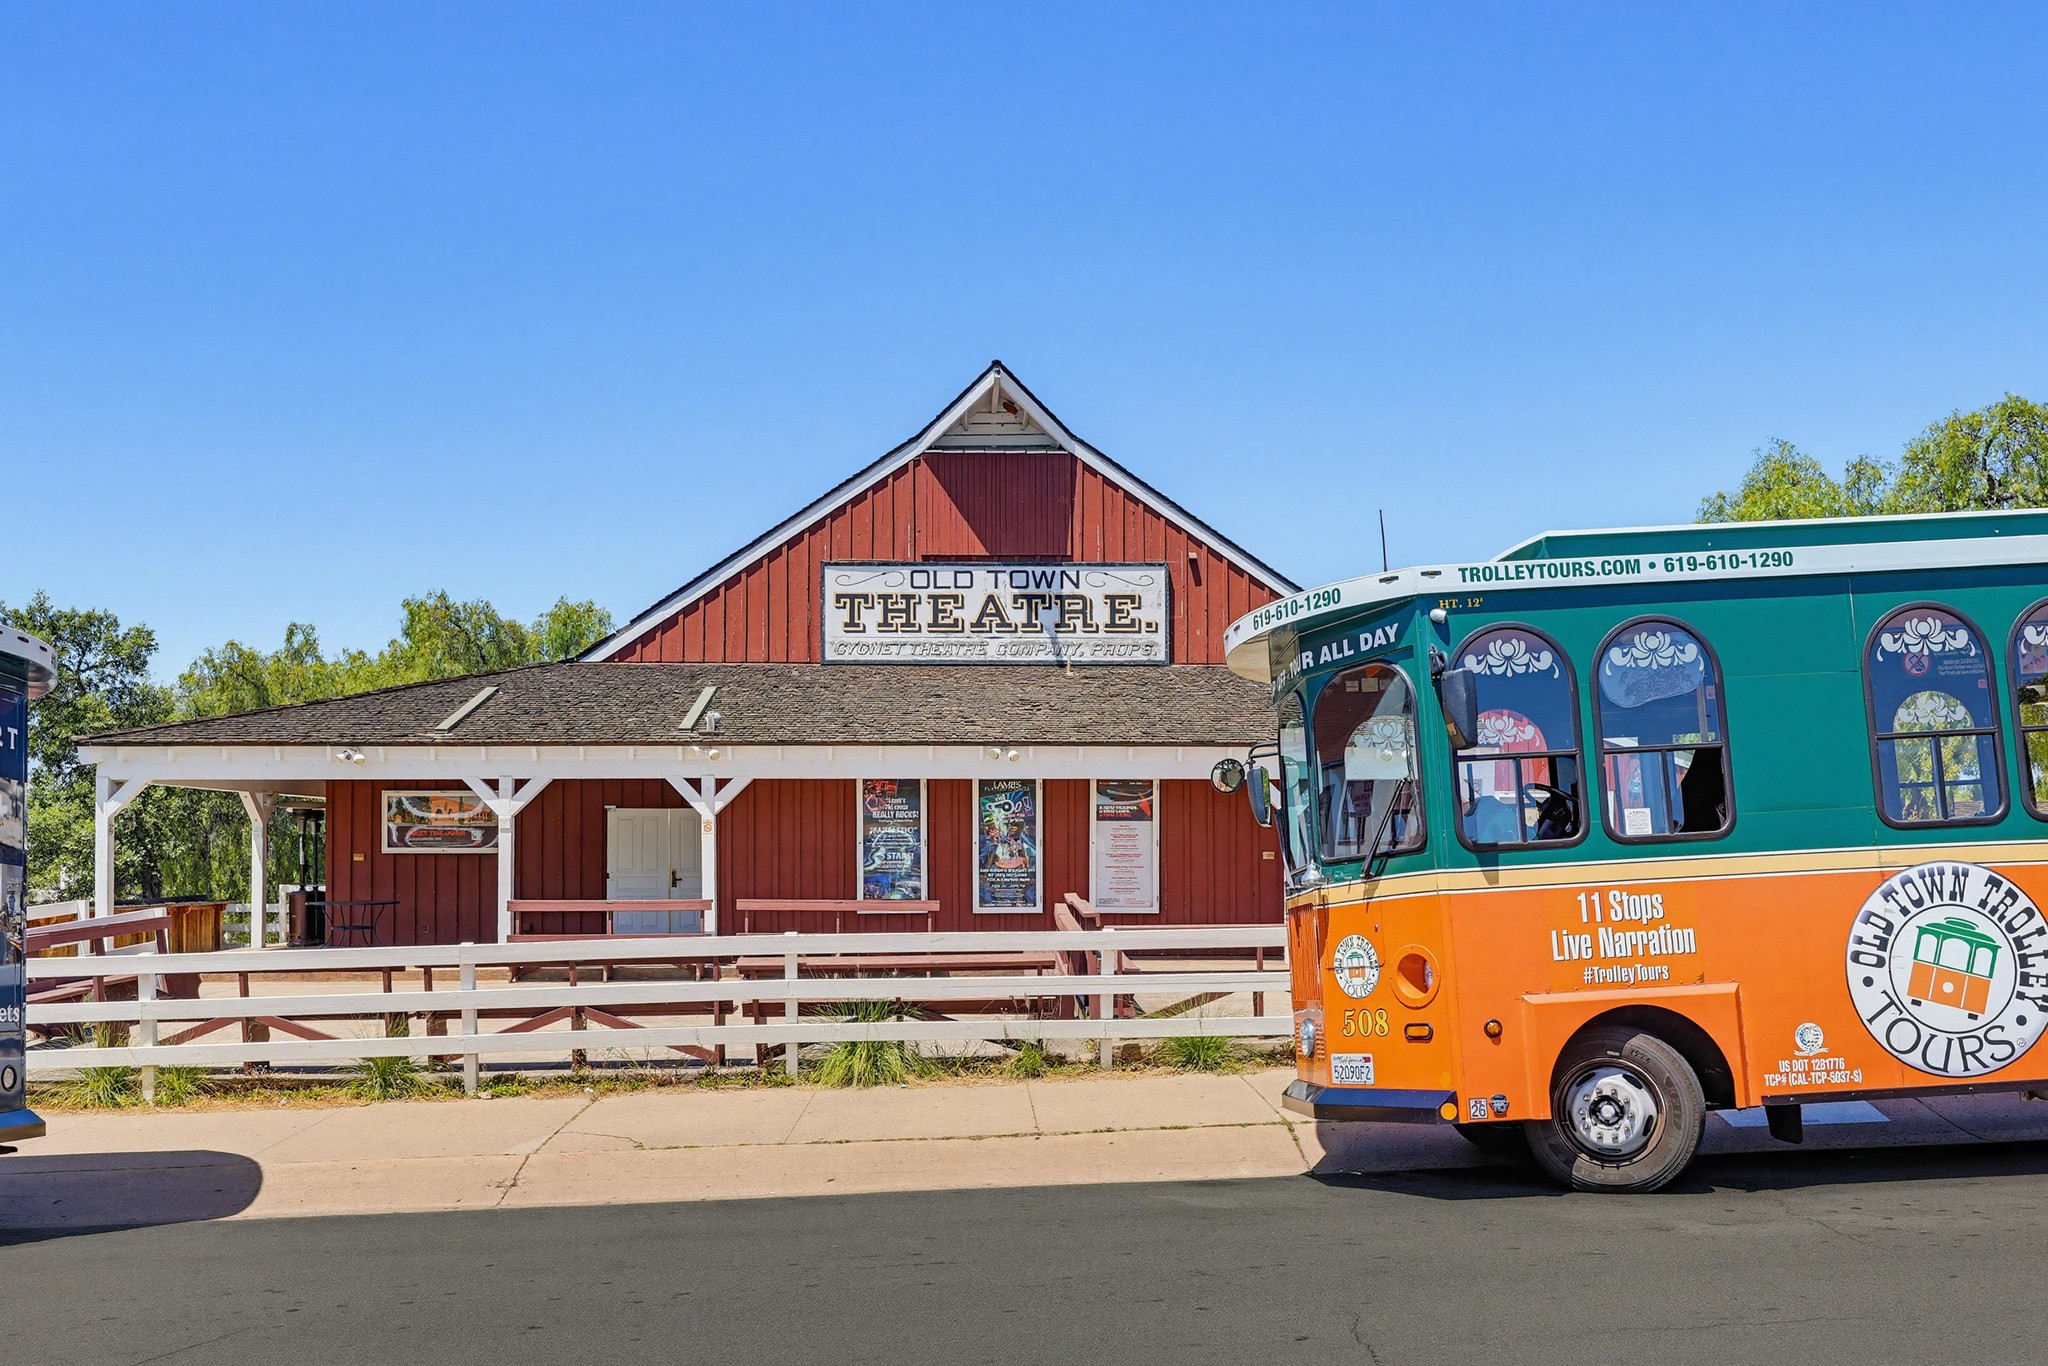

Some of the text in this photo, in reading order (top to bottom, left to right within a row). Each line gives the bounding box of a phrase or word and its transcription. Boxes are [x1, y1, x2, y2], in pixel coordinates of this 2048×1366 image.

[910, 569, 1080, 589] OLD TOWN
[1458, 551, 1794, 583] TROLLEYTOURS.COM 619-610-1290
[1253, 587, 1342, 630] 619-610-1290
[834, 639, 904, 657] CYGNET
[909, 639, 988, 657] THEATRE
[1320, 639, 1354, 664] ALL
[1360, 622, 1399, 652] DAY
[1577, 890, 1665, 925] 11 Stops
[1850, 909, 1895, 969] OLD
[1879, 866, 1970, 917] TOWN
[1551, 924, 1698, 961] Live Narration
[1343, 978, 1375, 998] TOURS
[1342, 1008, 1390, 1037] 508
[1866, 989, 2017, 1074] TOURS
[1778, 1060, 1791, 1073] US
[1792, 1059, 1809, 1072] DOT
[1471, 1104, 1487, 1118] 26
